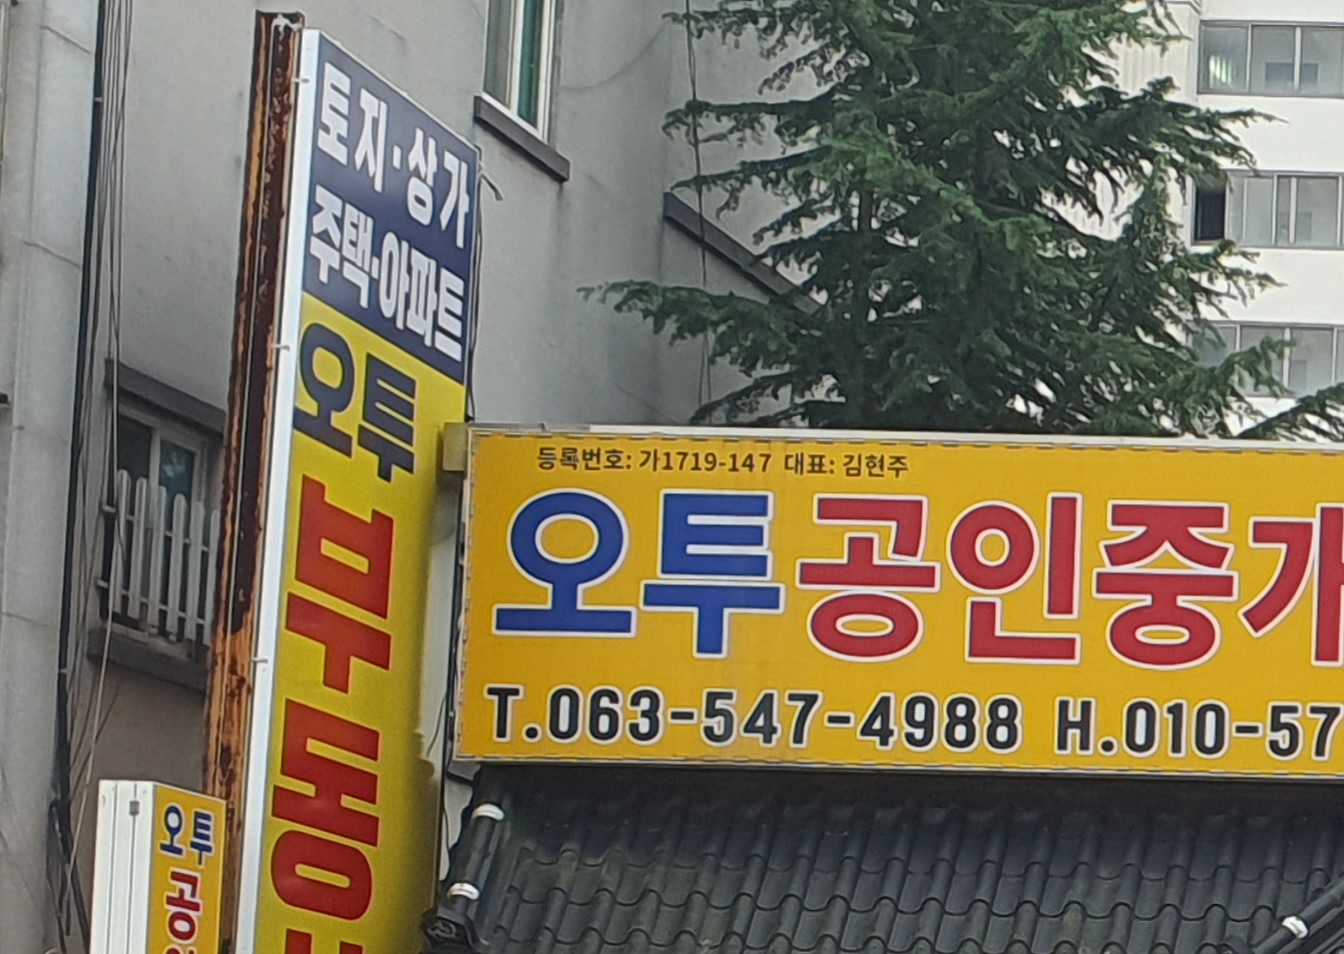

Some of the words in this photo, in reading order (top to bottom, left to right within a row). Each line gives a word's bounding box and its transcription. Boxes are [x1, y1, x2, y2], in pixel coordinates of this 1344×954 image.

[293, 321, 417, 483] 오투
[537, 448, 633, 472] 등록번호:
[639, 448, 773, 475] 가1719-147
[784, 452, 836, 476] 대표:
[843, 454, 909, 478] 김현주
[486, 684, 1022, 753] T.063-547-4988
[160, 803, 213, 866] 오투
